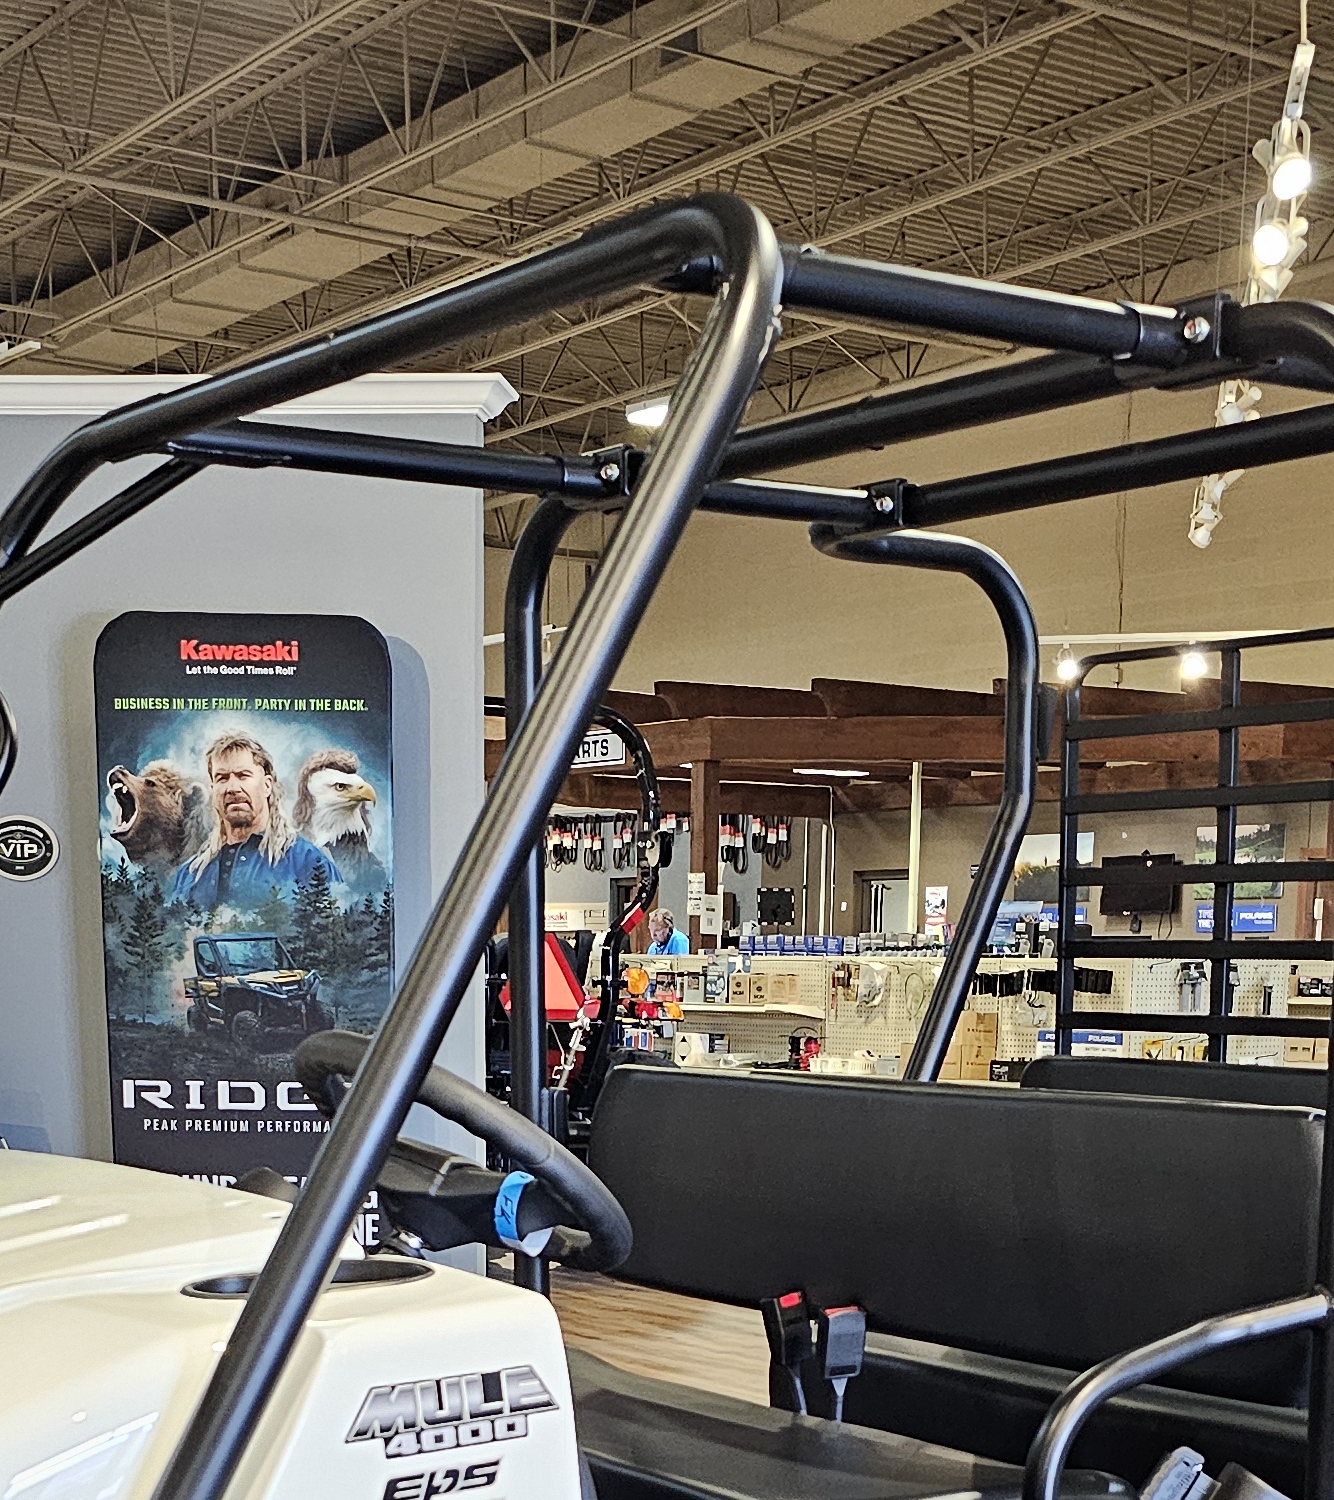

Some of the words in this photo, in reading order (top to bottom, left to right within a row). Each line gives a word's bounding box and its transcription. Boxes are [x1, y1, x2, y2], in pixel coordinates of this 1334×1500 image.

[180, 639, 299, 661] Kawasaki
[186, 665, 201, 674] Let
[203, 665, 218, 674] the
[220, 665, 244, 674] Good
[246, 666, 273, 675] Times
[114, 698, 169, 710] BUSINESS
[173, 698, 184, 710] IN
[188, 698, 208, 710] THE
[212, 698, 251, 710] FRONT.
[255, 698, 291, 710] PARTY
[295, 699, 306, 711] IN
[309, 699, 331, 711] THE
[334, 699, 368, 711] BACK.
[578, 738, 609, 758] RTS
[0, 842, 38, 858] VIP
[122, 1079, 318, 1111] RIDG
[144, 1118, 178, 1131] PEAK
[185, 1119, 249, 1132] PREMIUM
[257, 1120, 331, 1133] PERFORMA
[345, 1365, 560, 1443] MULE
[384, 1415, 527, 1459] 4000
